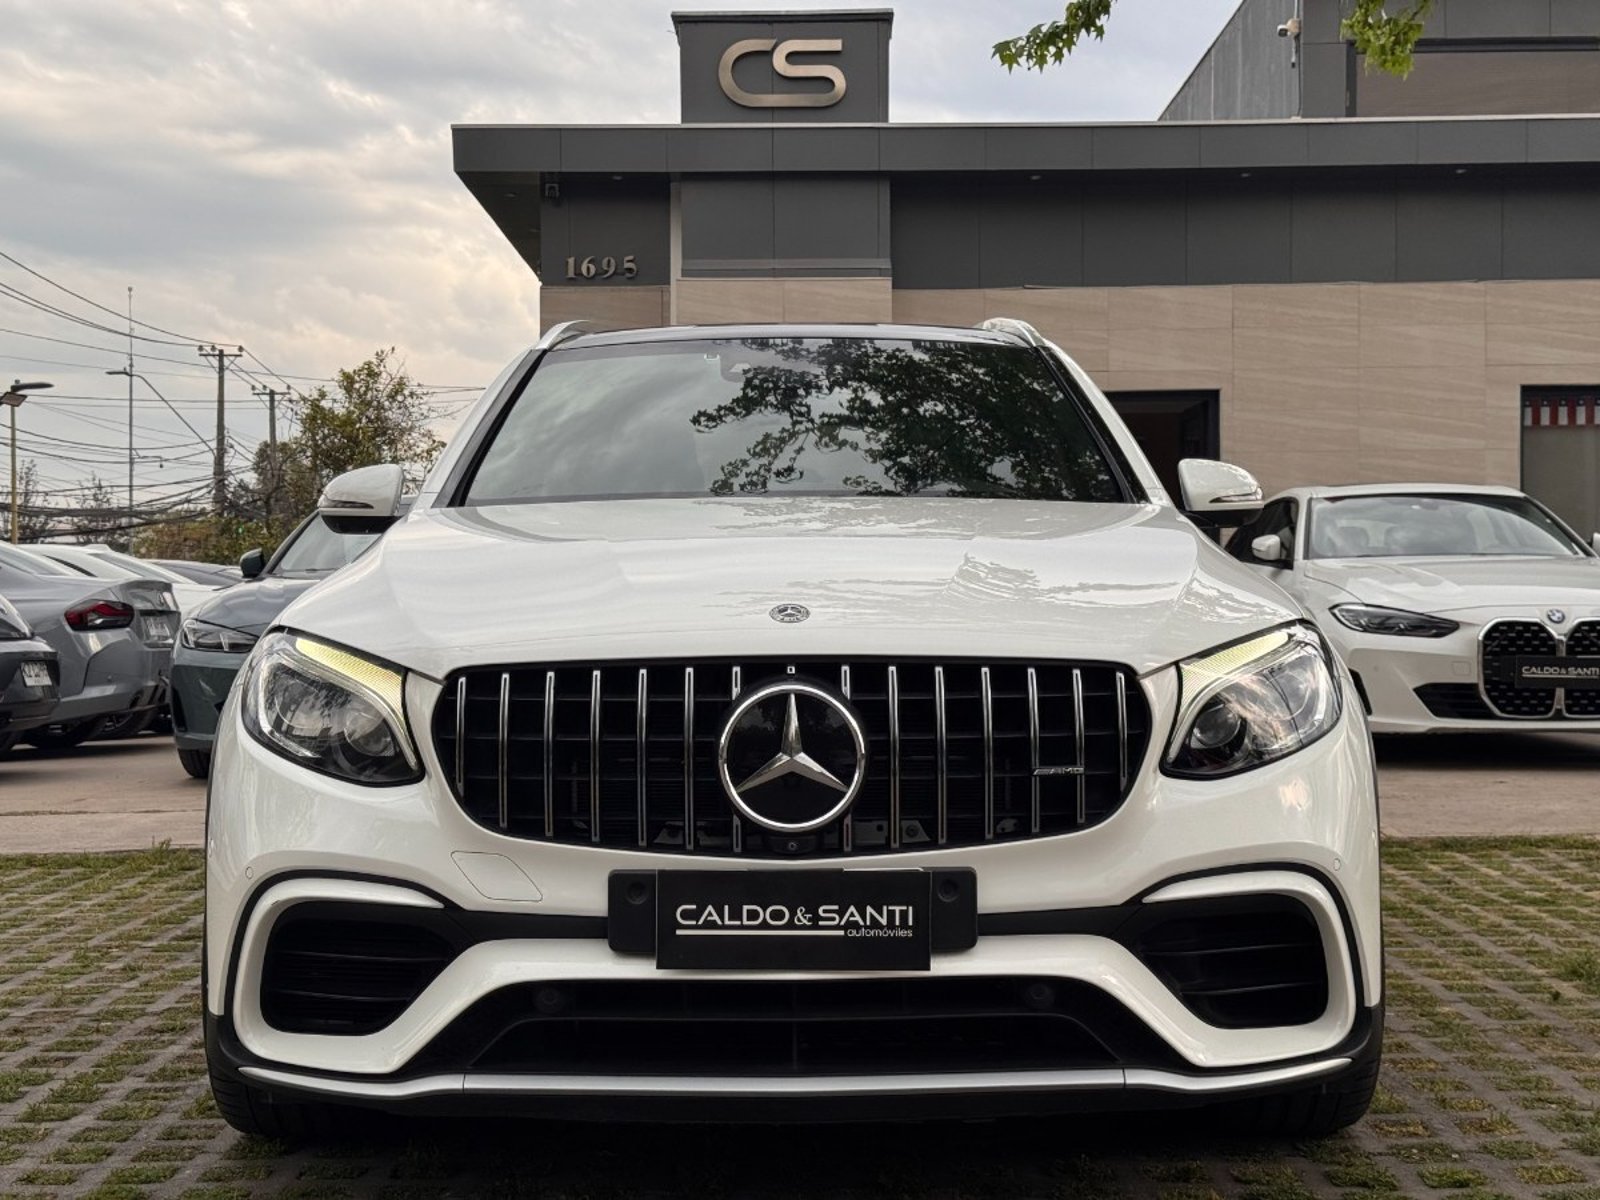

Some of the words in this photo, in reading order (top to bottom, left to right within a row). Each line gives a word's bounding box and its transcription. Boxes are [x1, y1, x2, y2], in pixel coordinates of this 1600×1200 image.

[718, 38, 847, 108] CS
[566, 255, 637, 279] 1695
[1521, 665, 1560, 675] CALDO
[675, 904, 790, 926] CALDO
[794, 906, 813, 926] &
[818, 904, 913, 926] SANTI
[847, 926, 913, 938] automóviles
